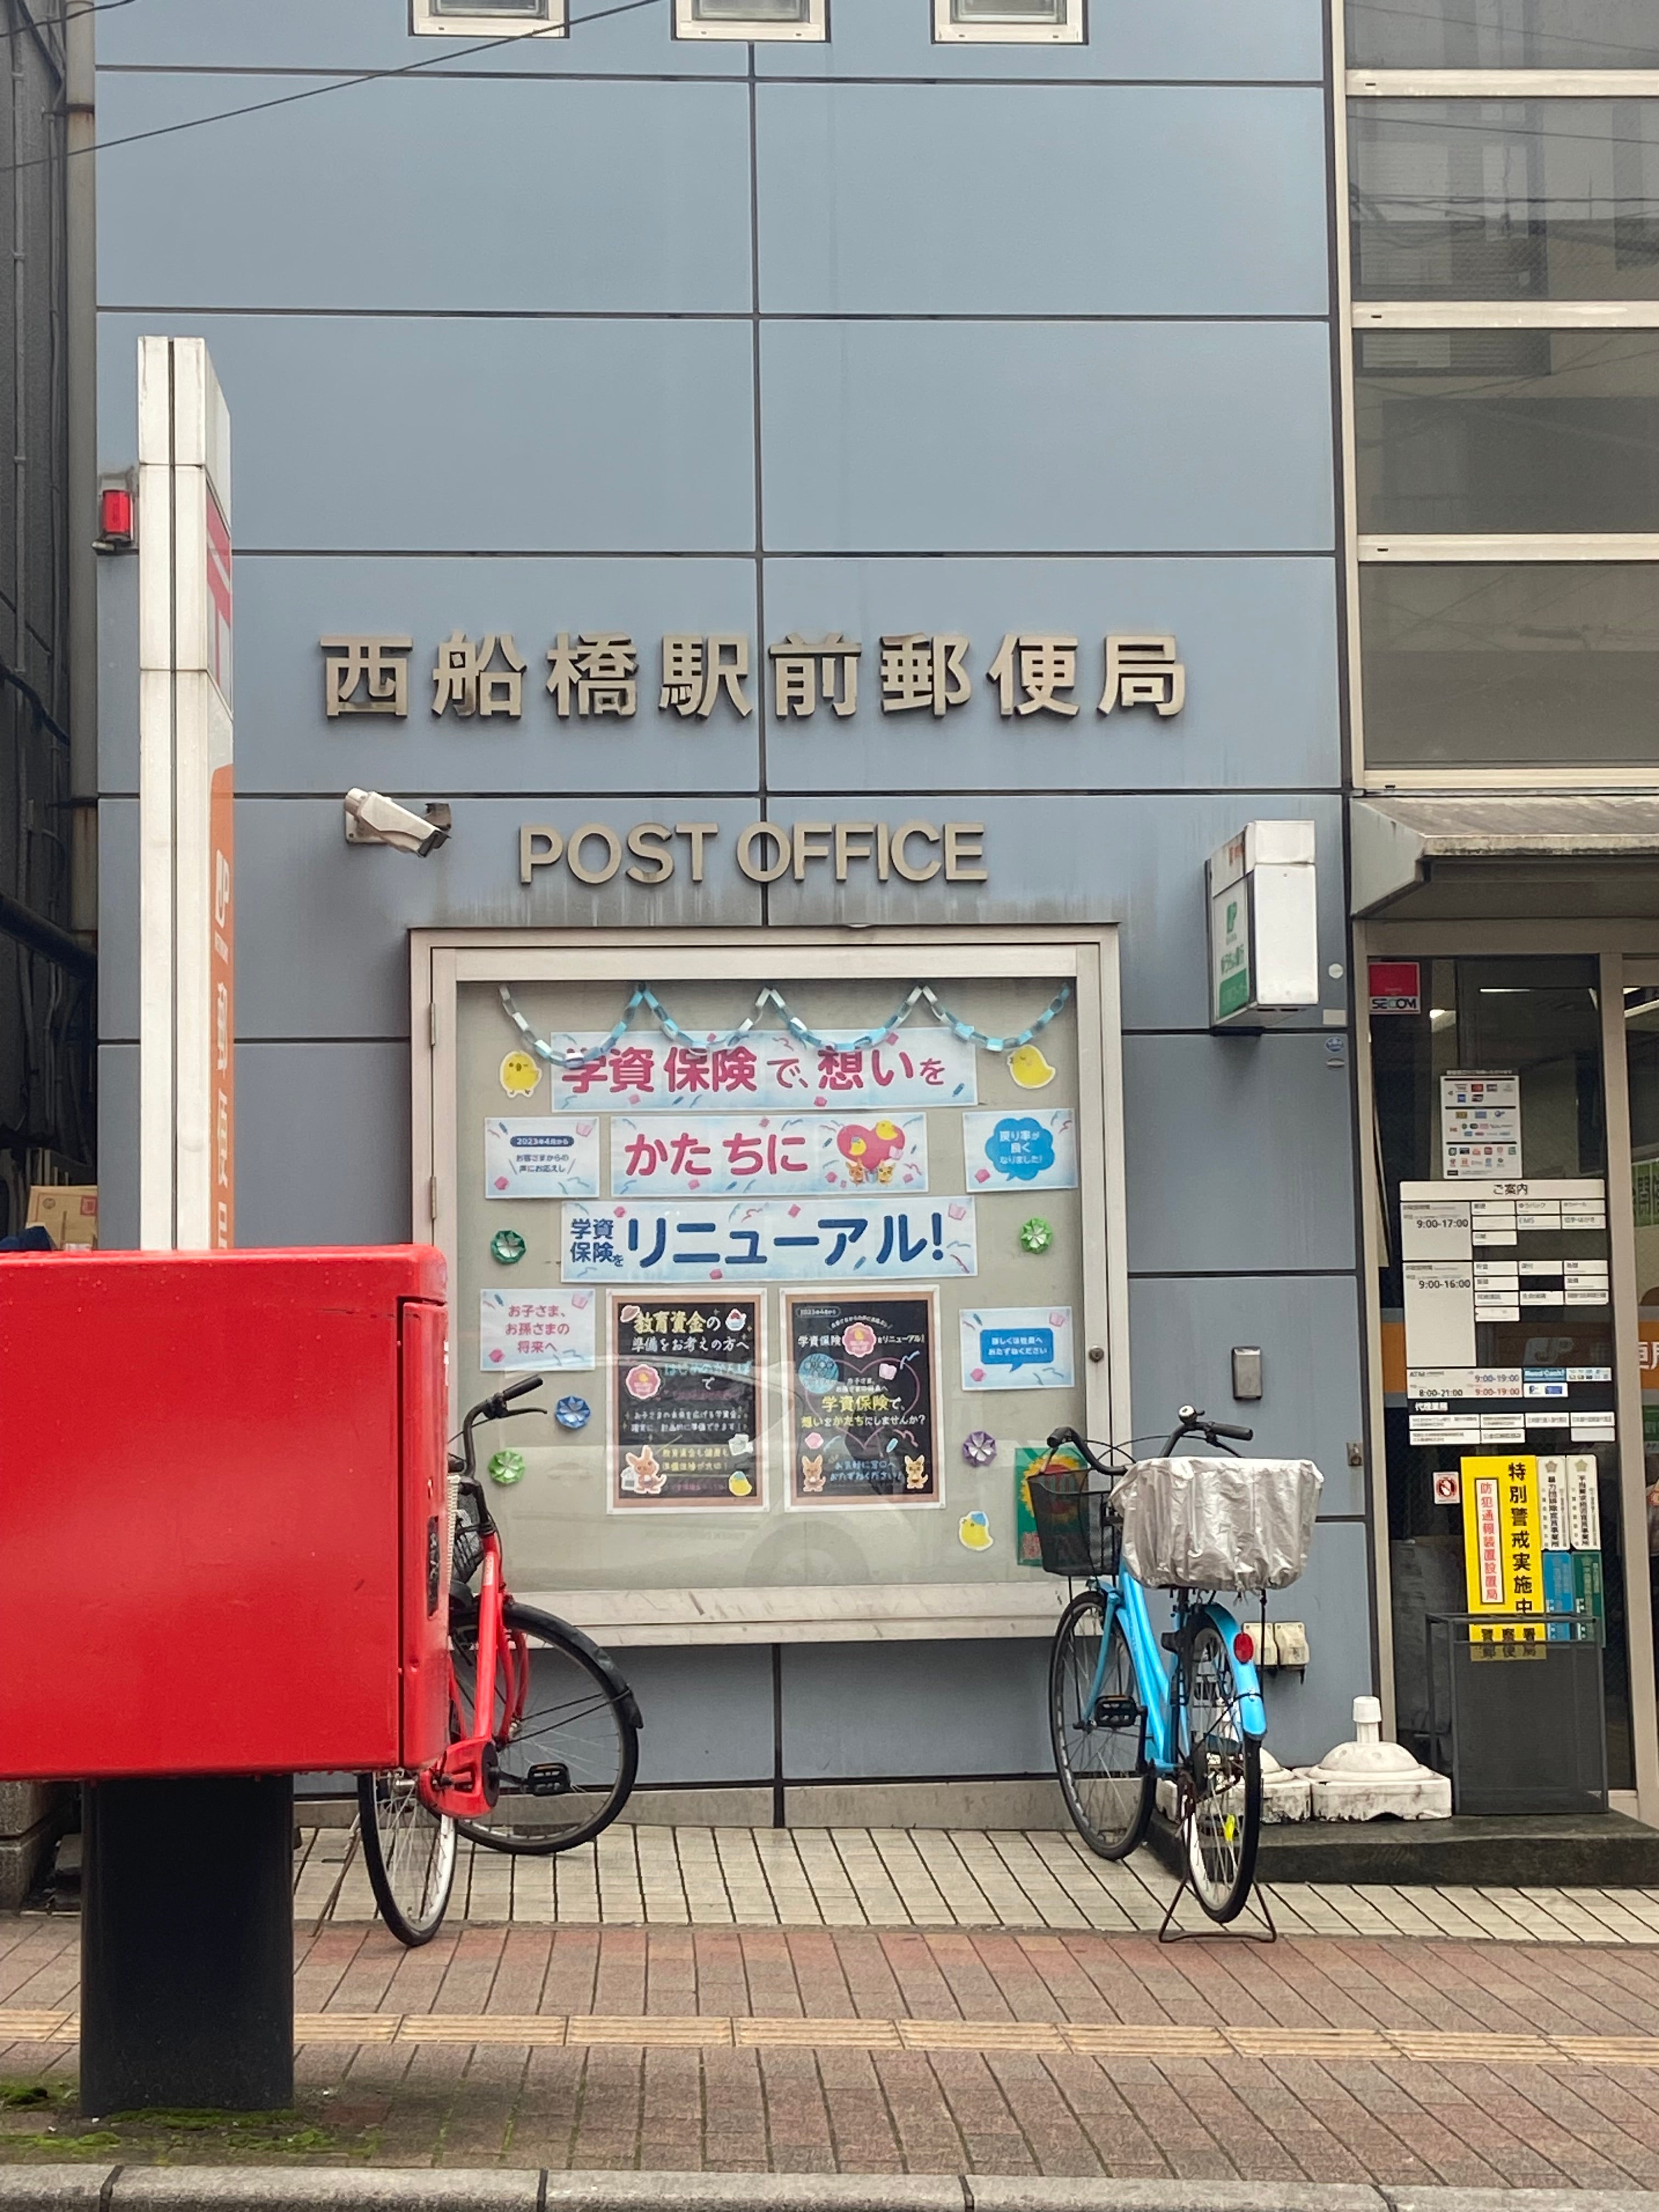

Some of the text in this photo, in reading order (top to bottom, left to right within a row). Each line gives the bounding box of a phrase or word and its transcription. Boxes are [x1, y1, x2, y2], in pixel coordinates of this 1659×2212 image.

[320, 629, 1186, 719] 西船橋駅前郵便局
[520, 821, 988, 884] POST OFFICE
[1372, 998, 1417, 1009] SECOM
[624, 1132, 808, 1176] かたちに
[1493, 1183, 1528, 1195] ご案内
[570, 1218, 613, 1240] 学資
[1417, 1219, 1469, 1228] 9:00-17:00
[628, 1212, 944, 1268] リニューアル!
[569, 1241, 624, 1267] 保険を
[1419, 1279, 1471, 1289] 9:00-16:00
[508, 1304, 566, 1317] お子さま、
[505, 1322, 570, 1335] お孫さまの
[633, 1309, 721, 1334] 教育資金の
[517, 1340, 558, 1354] 将来へ
[631, 1334, 750, 1353] 準備をお考えの方へ
[798, 1334, 842, 1347] 学資保険
[988, 1347, 1048, 1356] おたずねください
[1508, 1463, 1533, 1615] 特別警戒実施中
